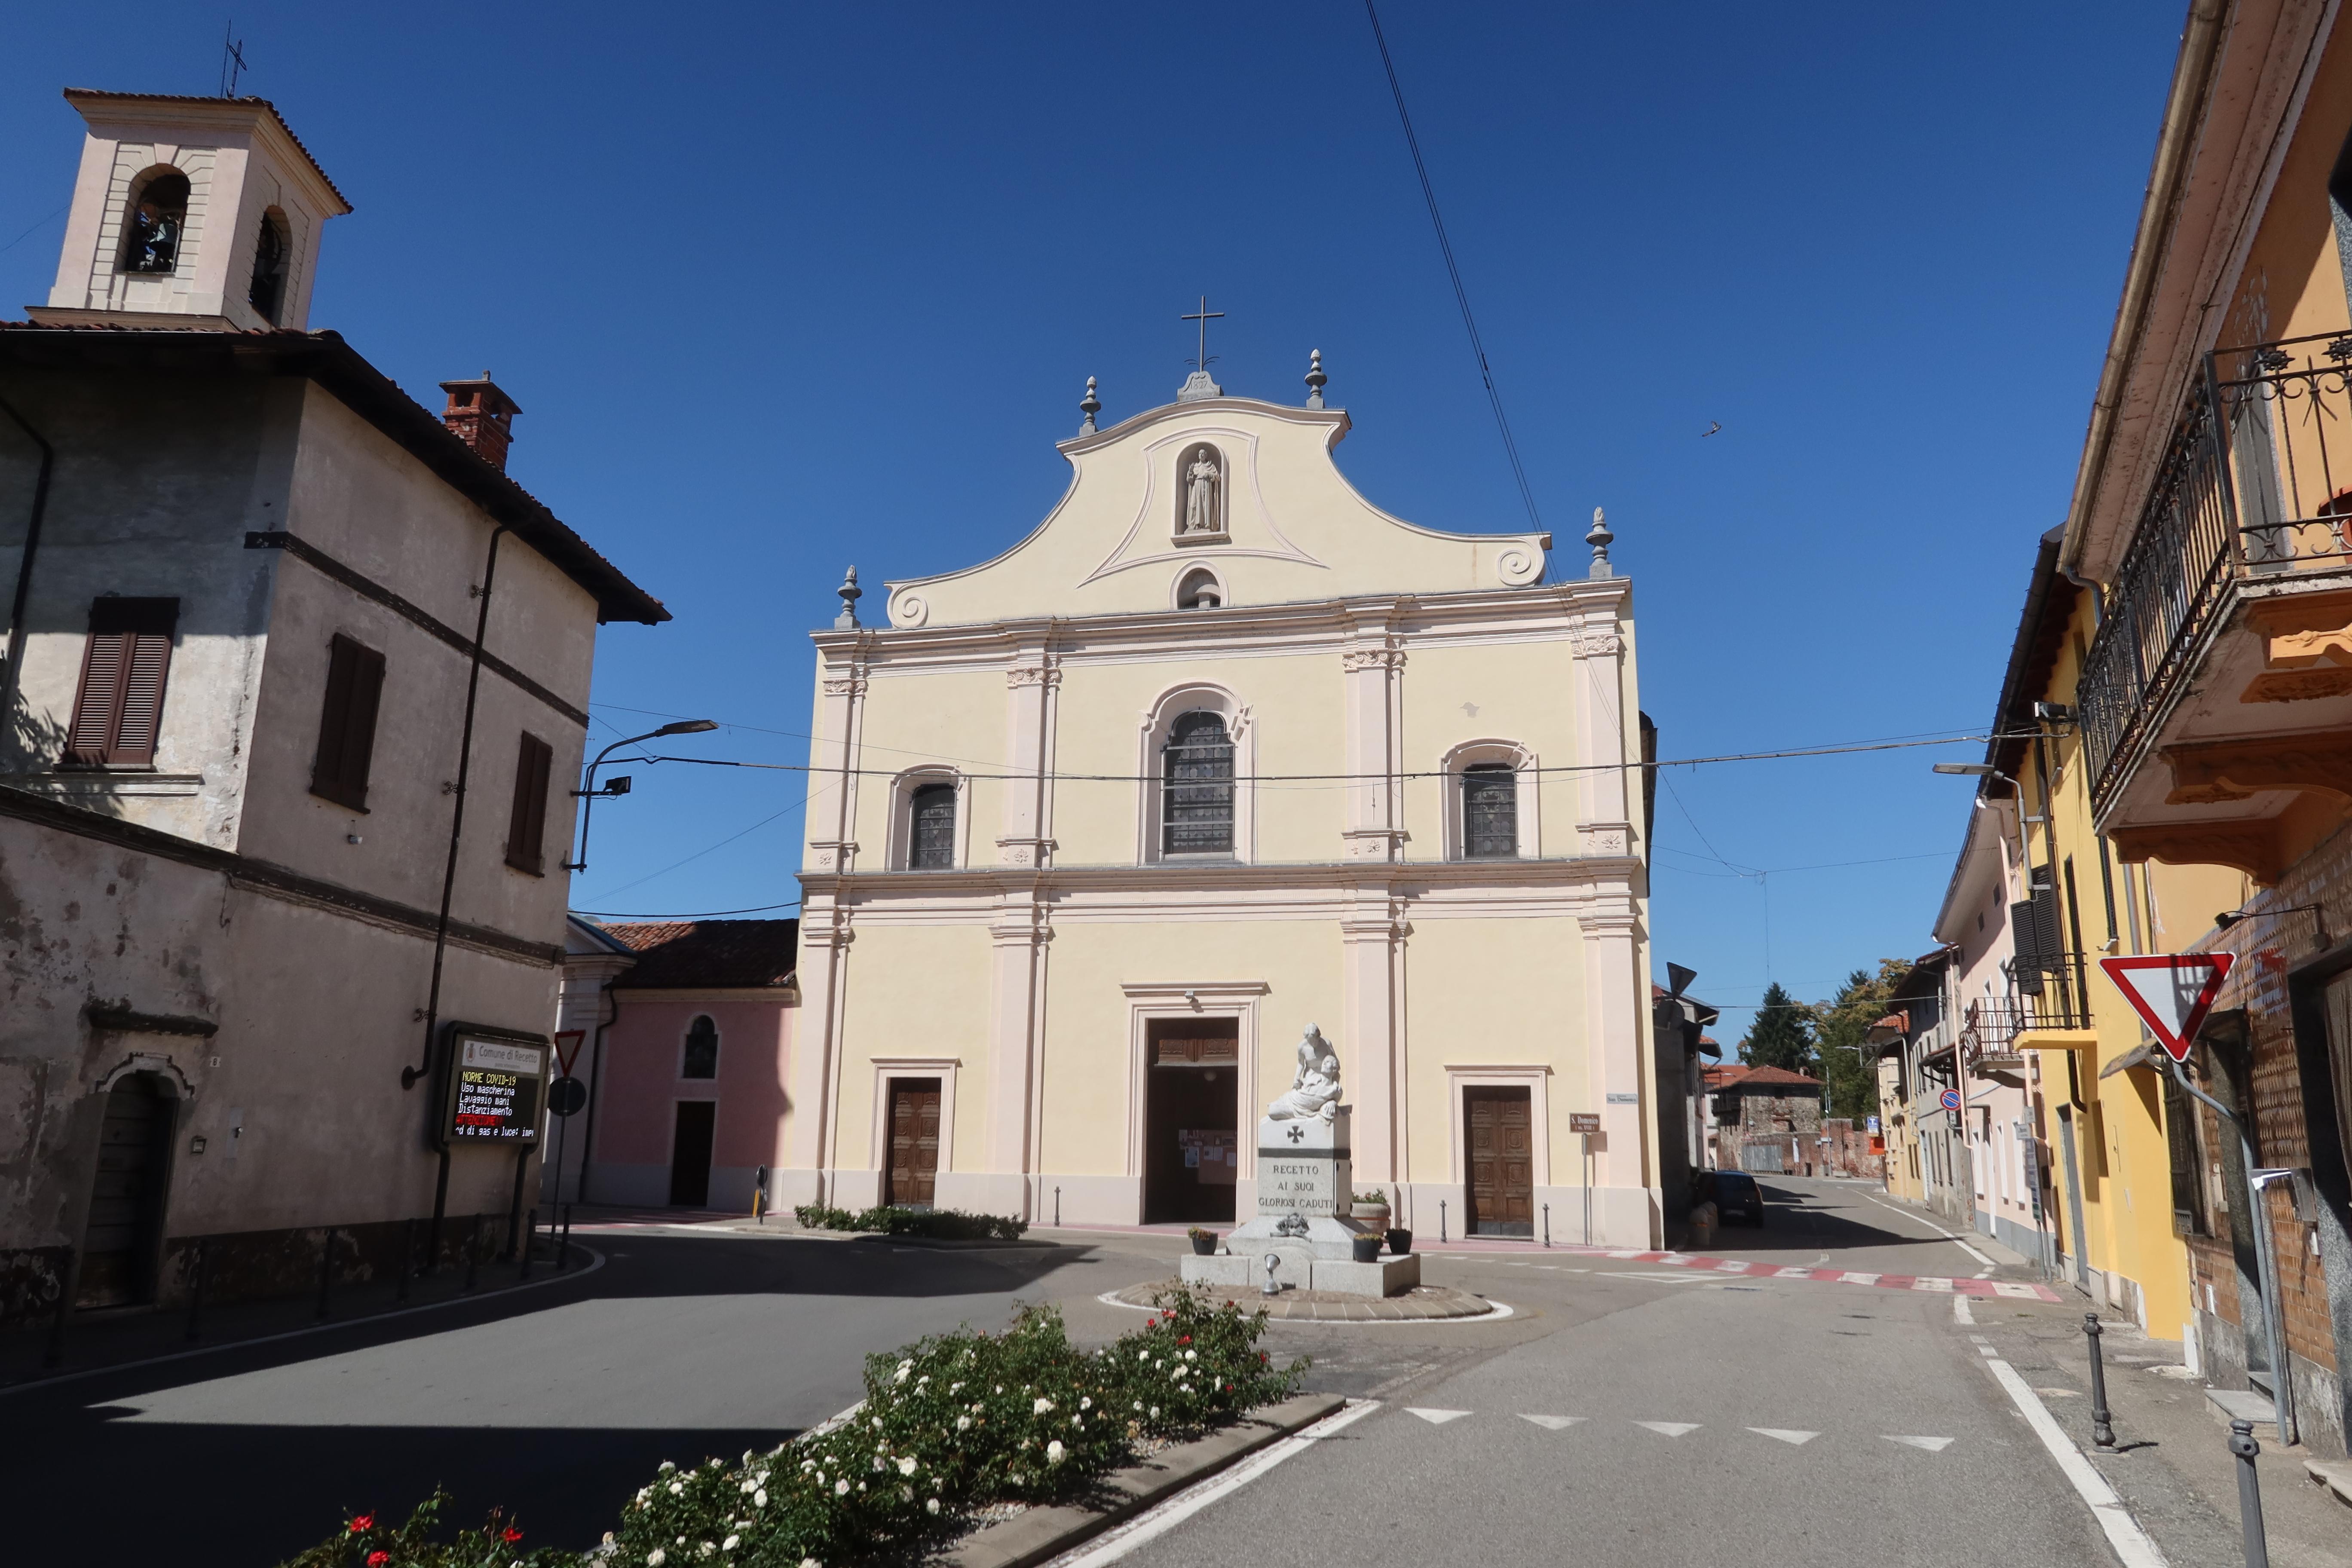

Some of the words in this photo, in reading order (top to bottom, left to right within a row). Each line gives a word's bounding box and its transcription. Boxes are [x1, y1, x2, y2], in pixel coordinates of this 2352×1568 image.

[1191, 381, 1208, 389] 1827
[479, 1045, 505, 1059] Comune
[507, 1049, 513, 1060] di
[515, 1050, 537, 1063] Recetto
[462, 1071, 484, 1083] NORME
[486, 1074, 517, 1086] COVID-19
[461, 1082, 474, 1092] Uso
[477, 1084, 515, 1096] mascherina
[459, 1093, 492, 1104] Lavaggio
[495, 1096, 510, 1106] mani
[458, 1103, 512, 1116] Distanziamento
[1571, 1115, 1576, 1124] S.
[1577, 1115, 1598, 1124] Domenico
[467, 1125, 475, 1135] di
[1273, 1165, 1319, 1174] RECETTO
[1278, 1182, 1288, 1191] AI
[1294, 1182, 1314, 1191] SUOI
[1259, 1198, 1295, 1207] GLORIOSI
[1299, 1199, 1332, 1208] CADUTI
